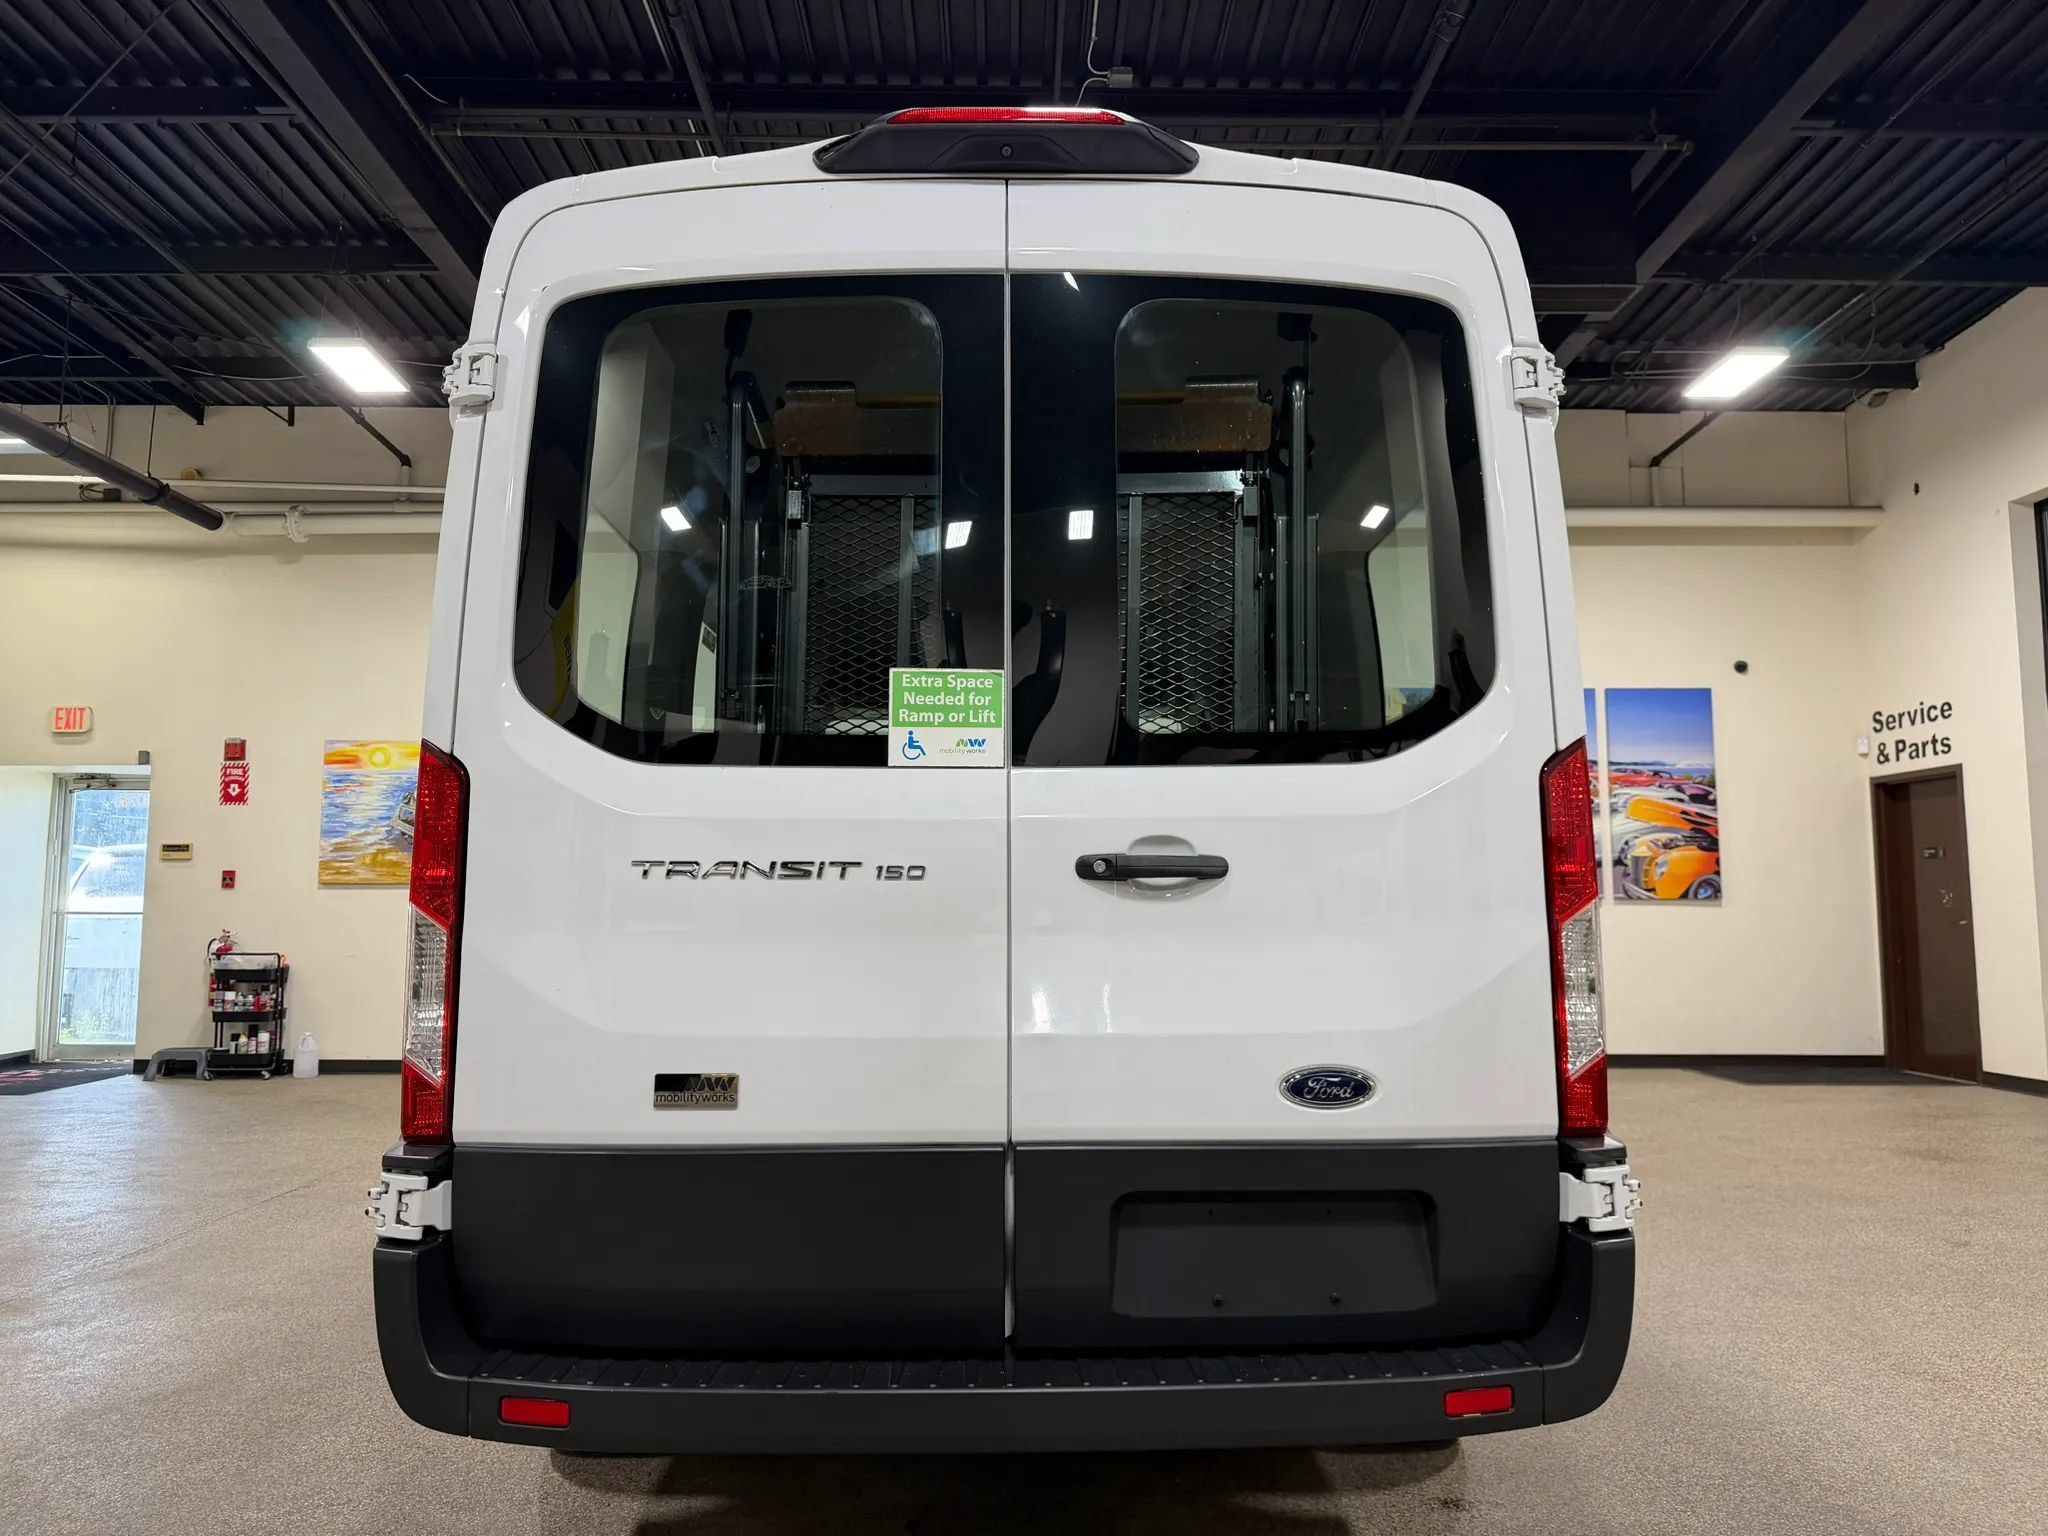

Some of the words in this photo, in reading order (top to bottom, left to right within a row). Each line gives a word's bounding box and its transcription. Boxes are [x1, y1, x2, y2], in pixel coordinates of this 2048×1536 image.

[902, 674, 943, 687] Extra
[947, 675, 993, 690] Space
[903, 692, 965, 706] Needed
[968, 692, 992, 706] for
[55, 707, 86, 730] EXIT
[899, 709, 945, 725] Ramp
[948, 712, 966, 723] or
[969, 710, 996, 723] Lift
[1872, 701, 1953, 733] Service
[1876, 742, 1891, 765] &
[1895, 733, 1952, 762] Parts
[226, 768, 244, 776] FIRE
[631, 860, 863, 880] TRANSIT
[875, 865, 926, 881] 150
[1303, 1076, 1356, 1098] Ford
[655, 1092, 736, 1104] mobilityworks
